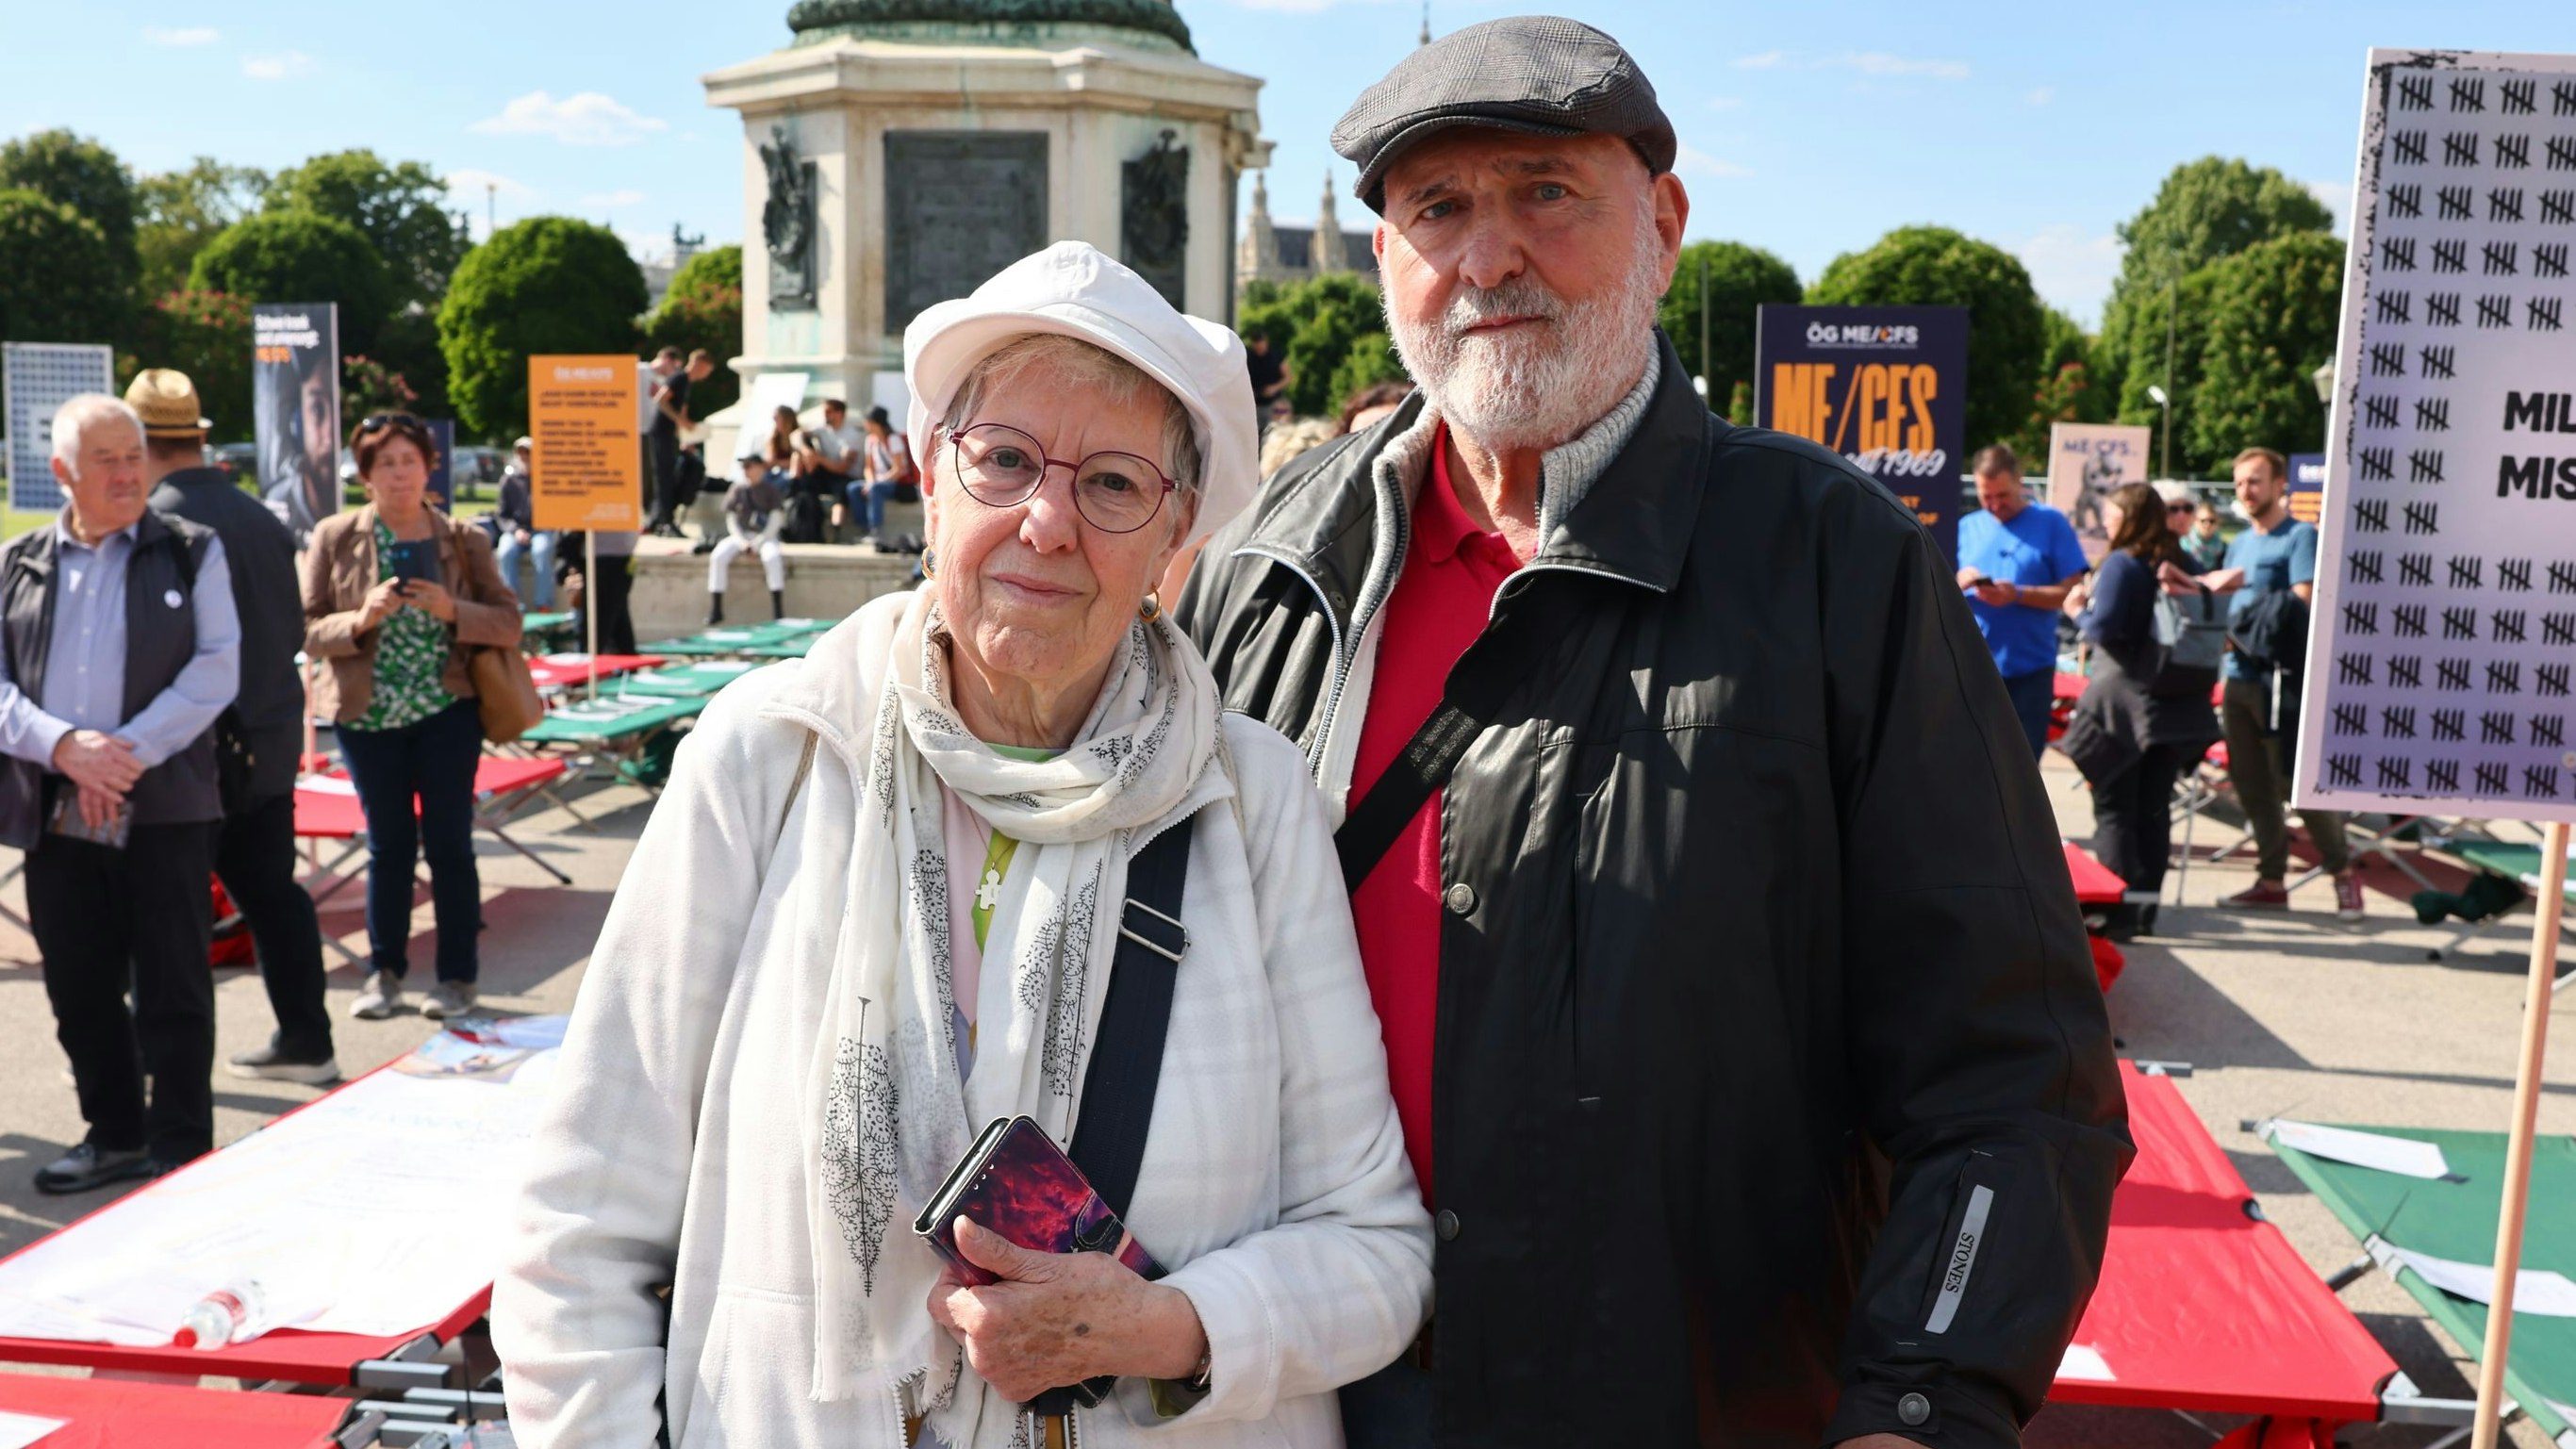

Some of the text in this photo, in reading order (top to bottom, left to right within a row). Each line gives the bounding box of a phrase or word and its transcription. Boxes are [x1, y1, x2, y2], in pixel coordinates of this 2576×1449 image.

[1807, 321, 1920, 343] ÖG ME/CFS
[1772, 363, 1938, 454] ME/CFS
[2503, 390, 2576, 434] MIL
[1883, 448, 1947, 476] 1969
[1945, 1232, 1975, 1293] STONES
